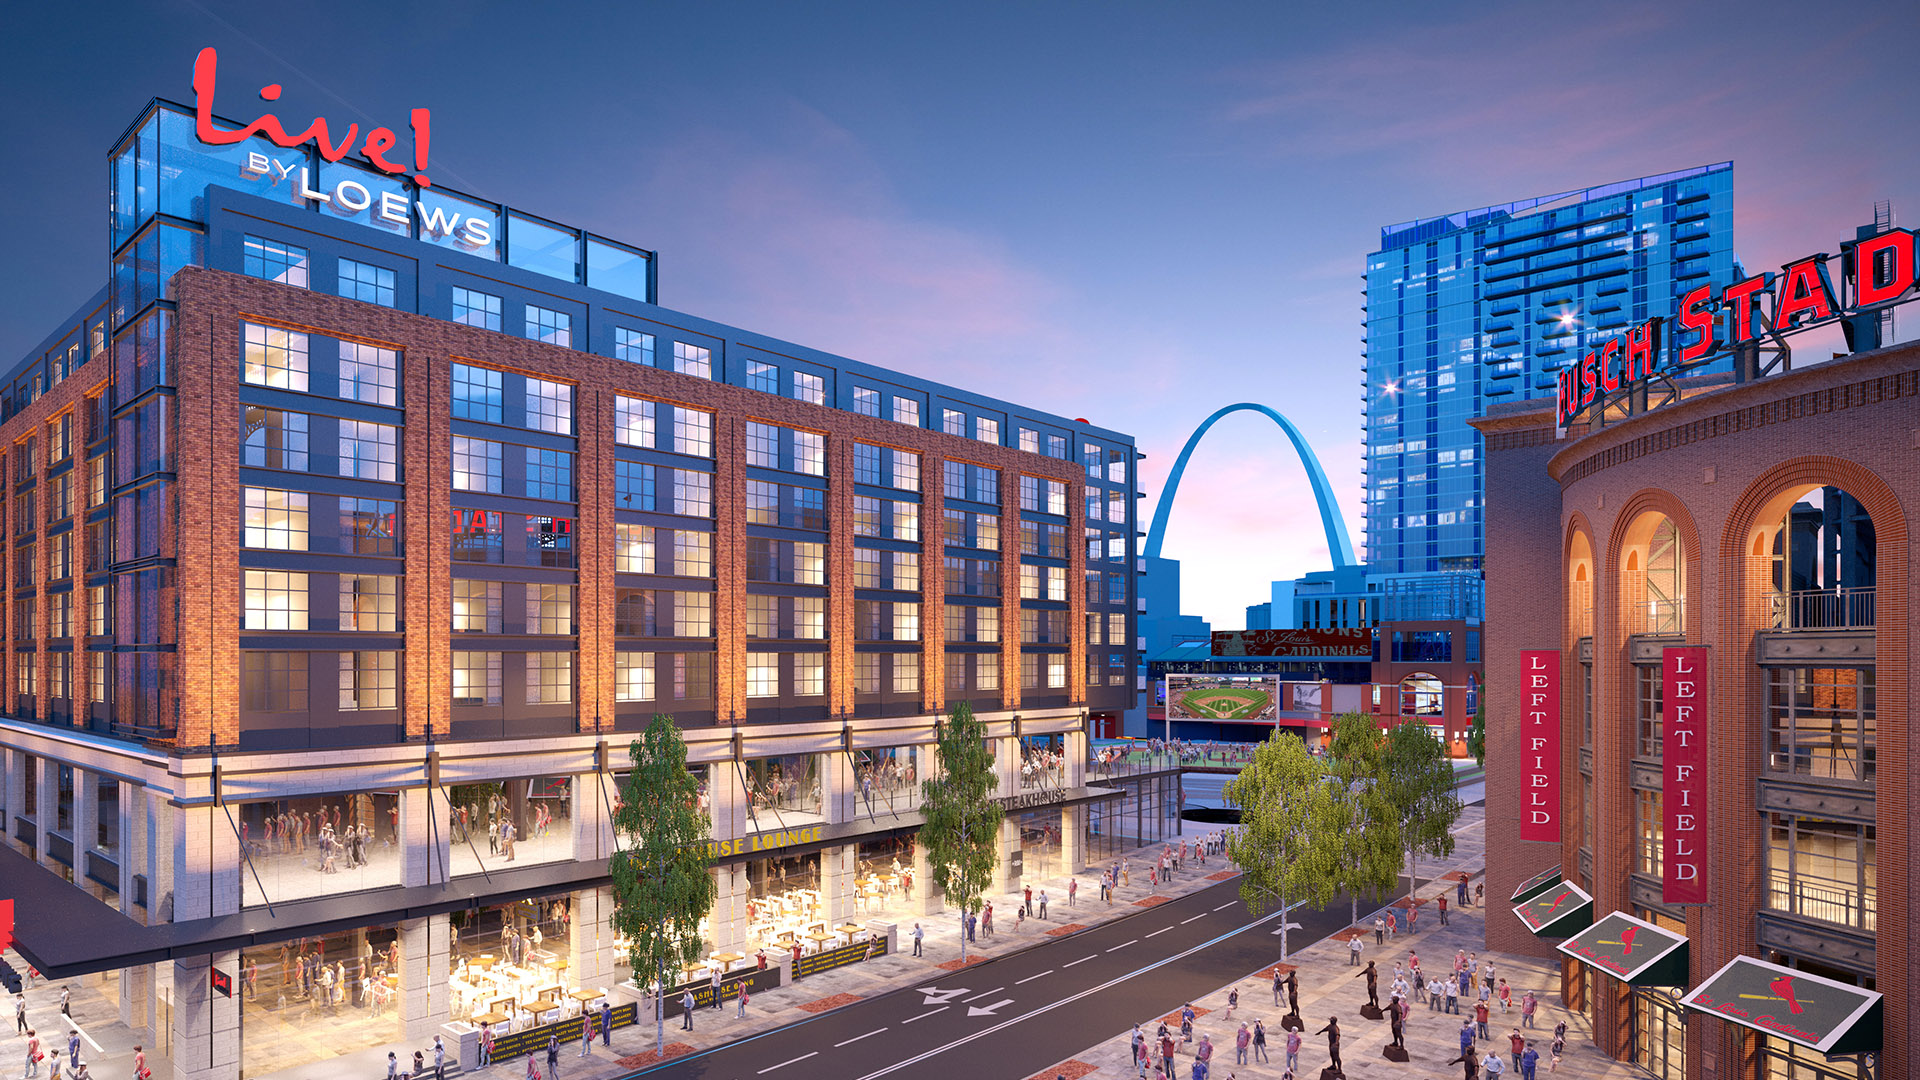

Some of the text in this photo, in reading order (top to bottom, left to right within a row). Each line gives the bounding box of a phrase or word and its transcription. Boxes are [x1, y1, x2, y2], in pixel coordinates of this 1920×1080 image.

[192, 47, 431, 187] Live!
[248, 152, 491, 246] BY LOEWS
[1678, 227, 1916, 362] STAD
[1530, 656, 1550, 824] LEFT FIELD
[1675, 656, 1697, 880] LEFT FIELD
[752, 826, 822, 852] LOUNGE
[1712, 1002, 1749, 1018] Louis
[1753, 1015, 1821, 1043] Cardinals
